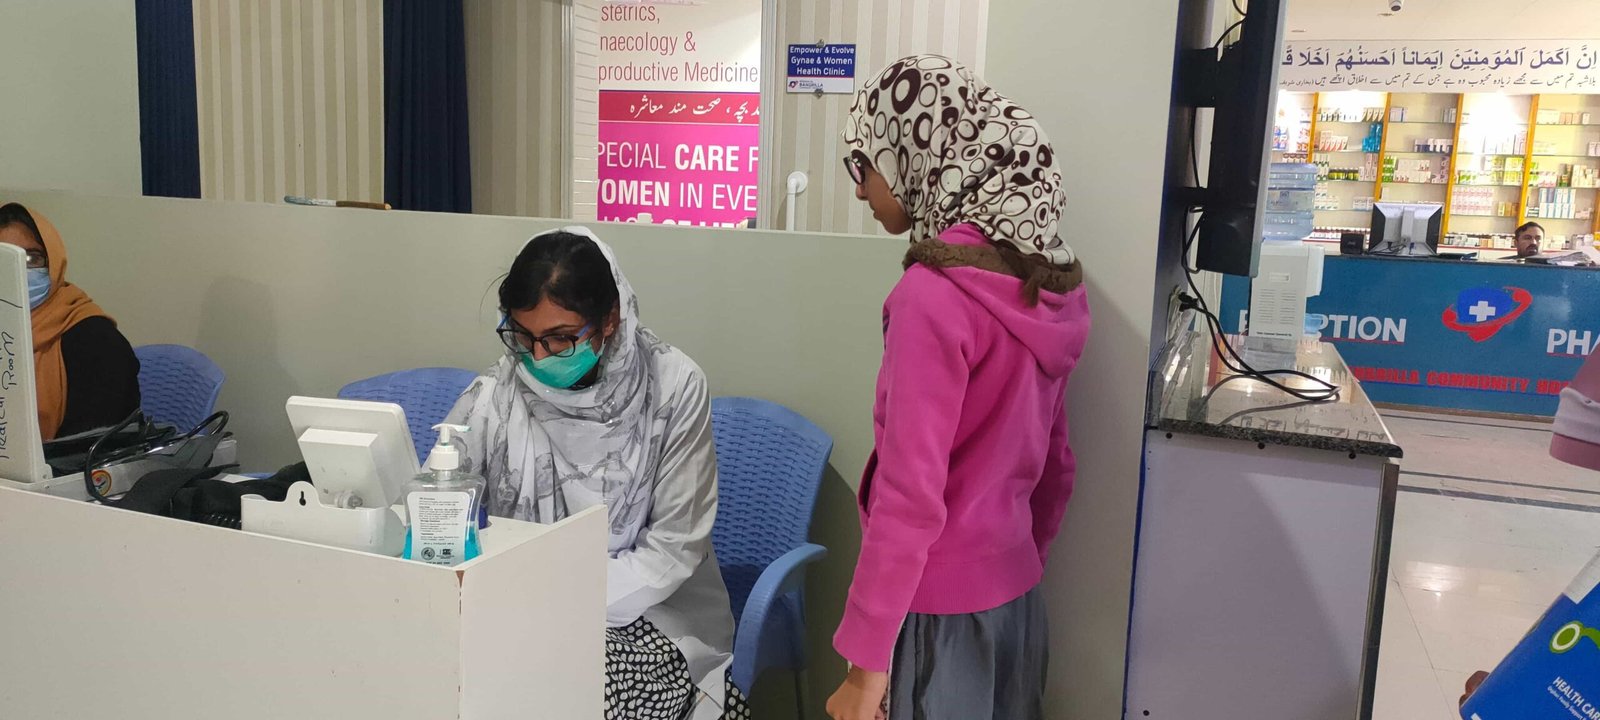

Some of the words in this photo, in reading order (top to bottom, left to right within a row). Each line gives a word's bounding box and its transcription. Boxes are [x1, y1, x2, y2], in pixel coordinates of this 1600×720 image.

[600, 32, 678, 55] naecology
[683, 31, 696, 52] &
[790, 46, 823, 55] Empower
[824, 46, 830, 54] &
[831, 46, 855, 54] Evolve
[598, 61, 679, 84] productive
[684, 61, 758, 82] Medicine
[791, 56, 815, 66] Gynae
[816, 56, 822, 64] &
[823, 56, 853, 65] Women
[796, 67, 822, 75] Health
[823, 67, 846, 76] Clinic
[674, 143, 740, 172] CARE
[597, 178, 670, 207] OMEN
[680, 182, 703, 209] IN
[1546, 328, 1600, 356] PH
[1427, 370, 1530, 393] COMMUNITY
[1552, 675, 1585, 707] HEALTH
